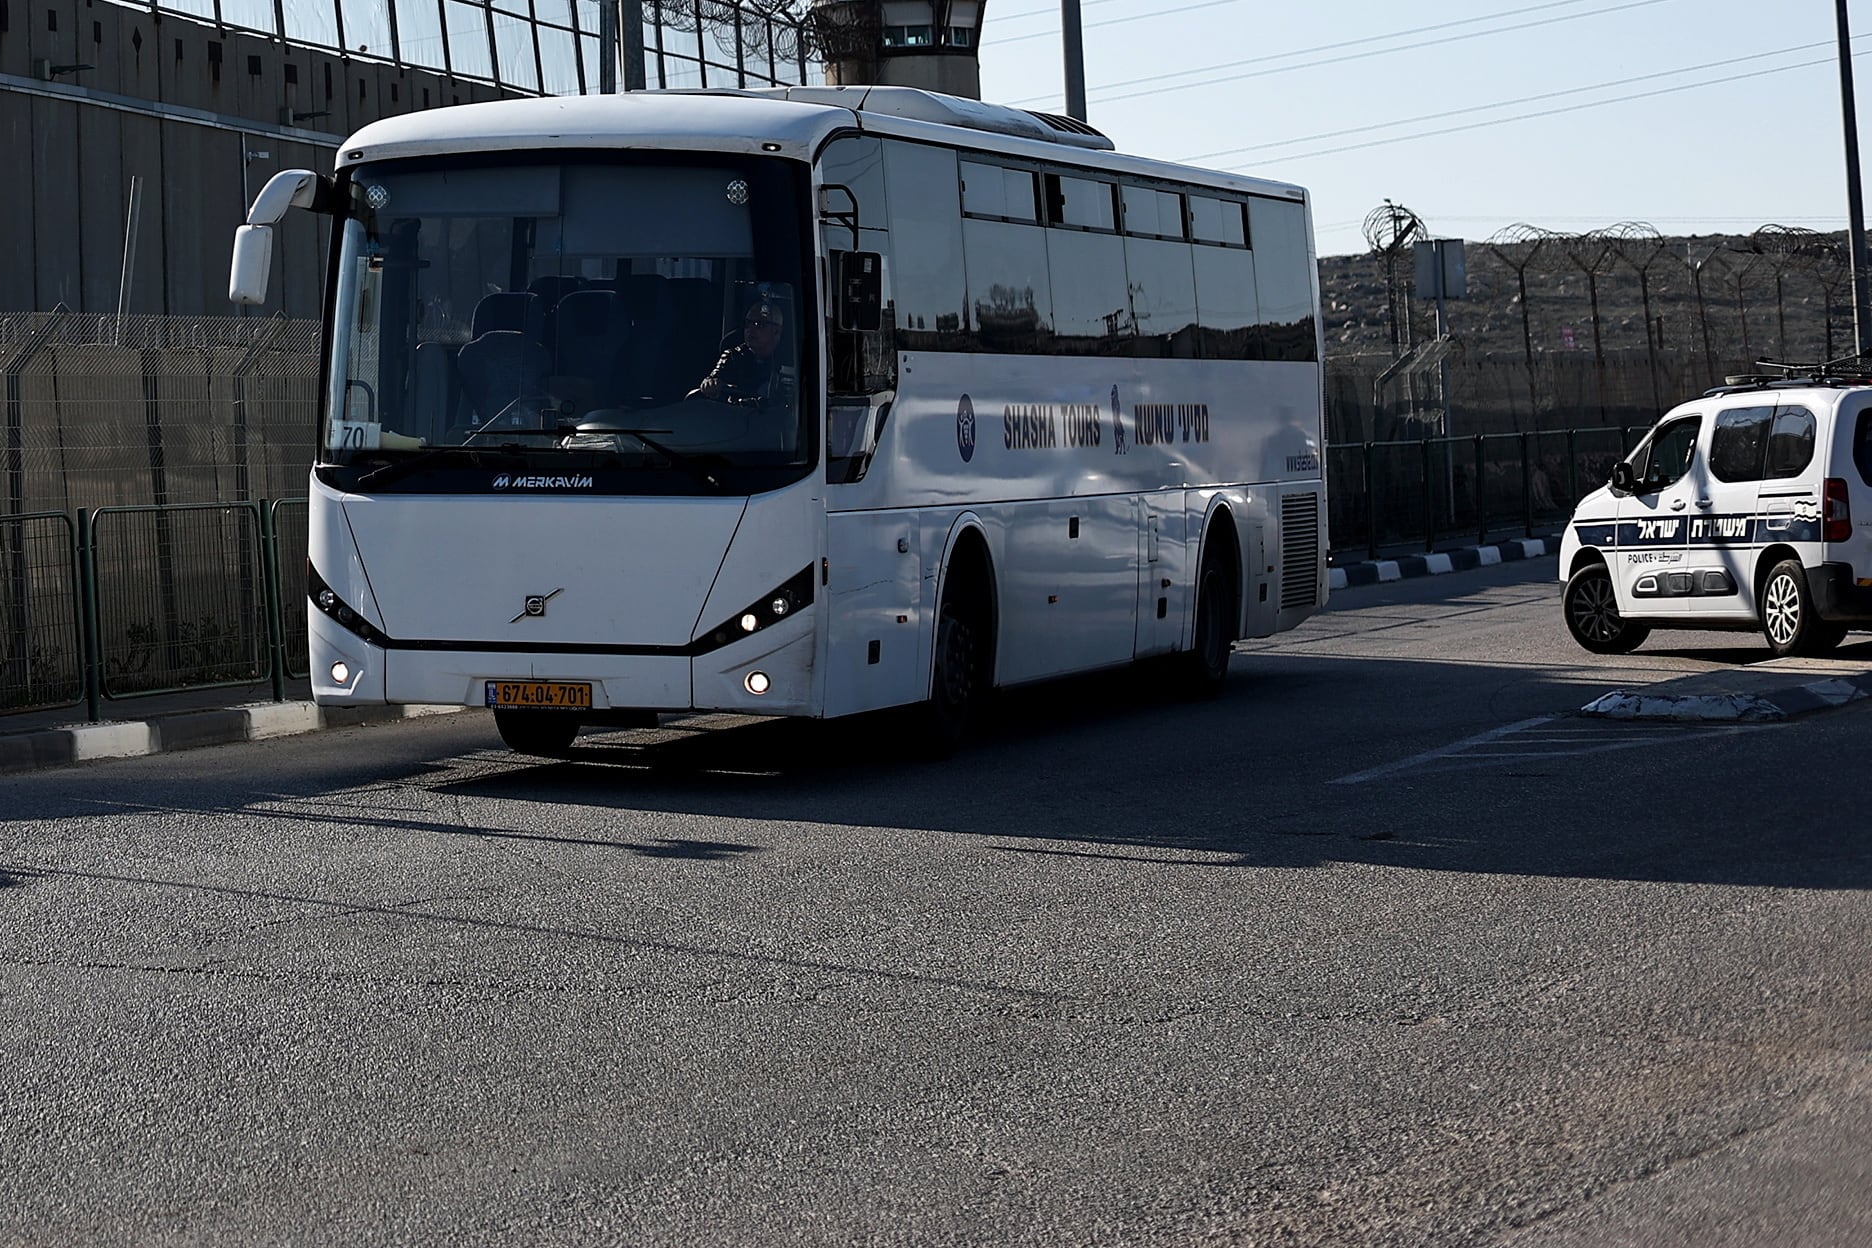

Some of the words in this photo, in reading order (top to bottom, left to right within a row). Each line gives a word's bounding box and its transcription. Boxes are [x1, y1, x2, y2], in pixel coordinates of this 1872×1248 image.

[1004, 404, 1056, 450] SHASHA
[1060, 403, 1102, 448] TOURS
[1134, 403, 1175, 445] שאשא
[343, 426, 365, 450] 70
[1637, 518, 1680, 540] ישראל
[1691, 517, 1747, 538] משטרת
[1628, 553, 1653, 564] POLICE
